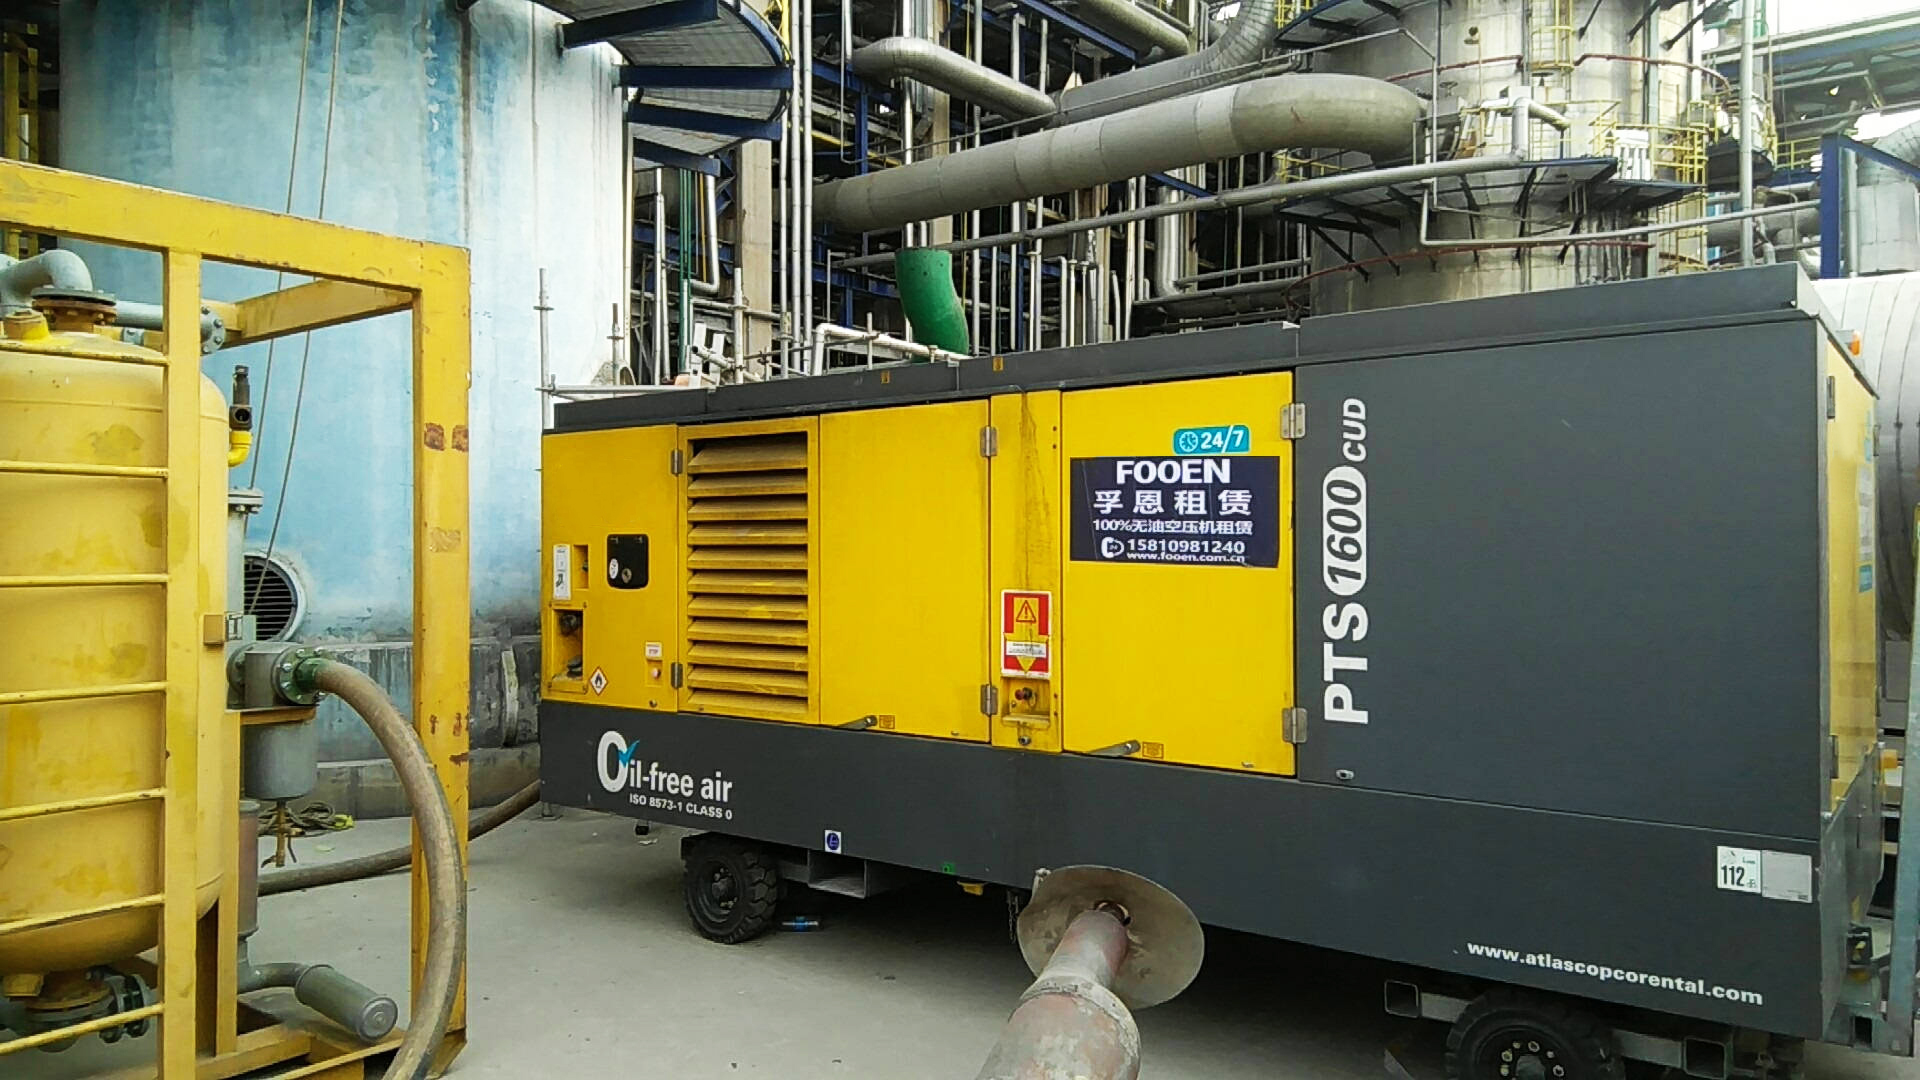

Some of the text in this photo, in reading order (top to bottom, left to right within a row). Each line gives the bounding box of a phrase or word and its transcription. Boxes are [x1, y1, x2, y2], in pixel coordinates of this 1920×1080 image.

[1200, 427, 1244, 452] 24/7
[1116, 459, 1231, 485] FOOEN
[1093, 489, 1252, 516] 孚恩租赁
[1093, 519, 1253, 535] 100%无油空压机租赁
[1326, 479, 1362, 584] 1600
[1127, 538, 1245, 554] 15810981240
[1127, 551, 1245, 563] www.fooen.com.cn
[1323, 603, 1369, 724] PTS
[598, 731, 733, 803] Oil-free air
[629, 793, 647, 806] ISO
[649, 796, 682, 812] 8573-1
[686, 802, 723, 818] CLASS
[1721, 865, 1745, 887] 112
[1467, 942, 1764, 1006] www.atlascopcorental.com
